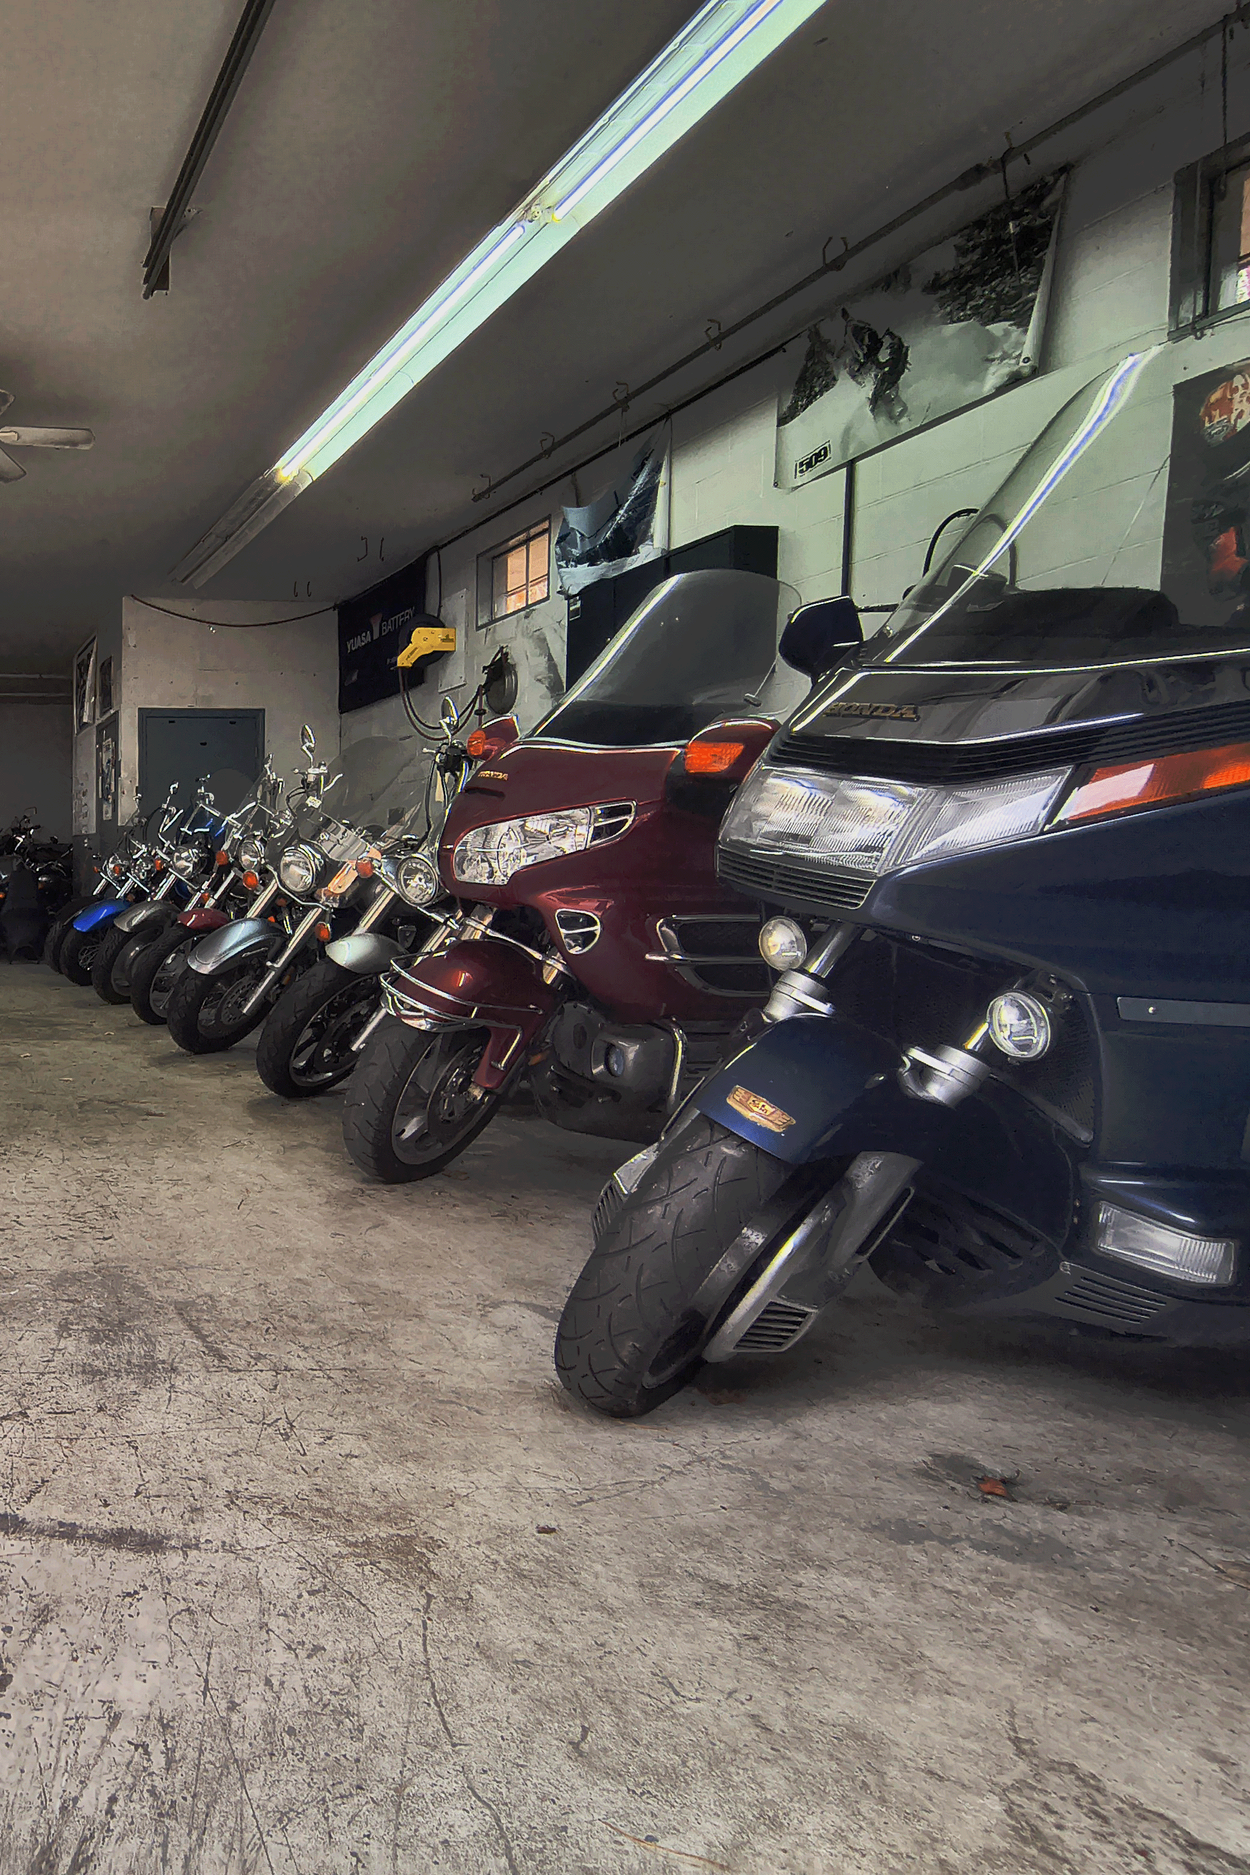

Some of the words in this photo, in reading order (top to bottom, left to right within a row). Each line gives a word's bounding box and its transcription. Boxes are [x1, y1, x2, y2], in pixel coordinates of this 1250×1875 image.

[798, 446, 829, 474] 509
[346, 631, 371, 653] YUASA
[381, 606, 416, 636] BATTERY
[824, 702, 918, 721] HONDA
